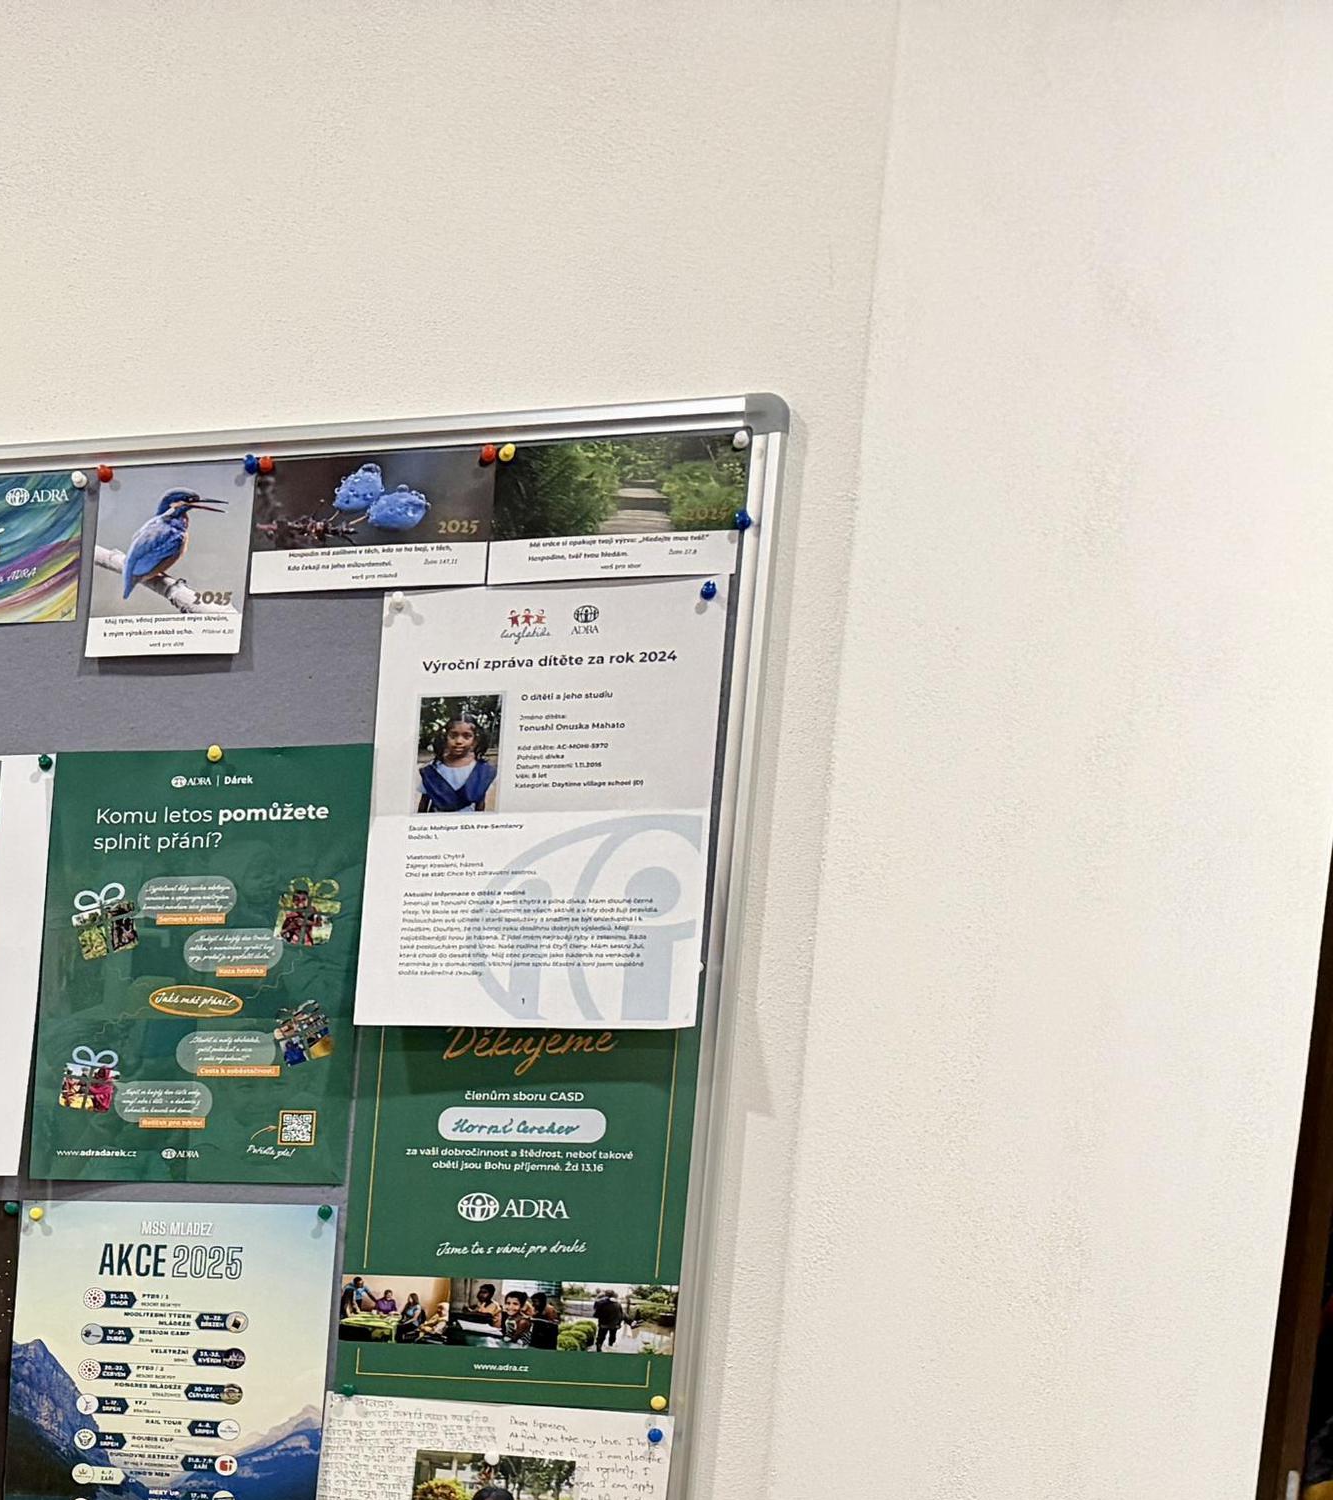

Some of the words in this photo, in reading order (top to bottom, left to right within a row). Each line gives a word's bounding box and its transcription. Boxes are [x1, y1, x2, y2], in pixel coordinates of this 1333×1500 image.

[30, 487, 69, 503] ADRA
[437, 518, 479, 535] 2025
[193, 591, 233, 606] 2025
[422, 657, 479, 674] Výroční
[484, 657, 534, 671] zpráva
[538, 654, 584, 668] dítěte
[587, 654, 605, 665] za
[608, 651, 634, 664] rok
[639, 650, 677, 663] 2024
[187, 777, 211, 786] ADRA
[224, 775, 253, 785] Dárek
[96, 807, 157, 825] Komu
[164, 806, 213, 823] letos
[218, 802, 329, 826] pomůžete
[93, 832, 151, 853] splnit
[157, 831, 223, 852] přání?
[443, 1027, 619, 1076] Děkujeme
[465, 1090, 511, 1102] členům
[513, 1091, 547, 1102] sboru
[550, 1091, 584, 1102] CASD
[57, 1149, 137, 1158] www.adradarek.cz
[501, 1199, 571, 1219] ADRA
[99, 1243, 167, 1277] AKCE
[172, 1246, 243, 1279] 2025
[473, 1362, 529, 1372] www.adra.cz
